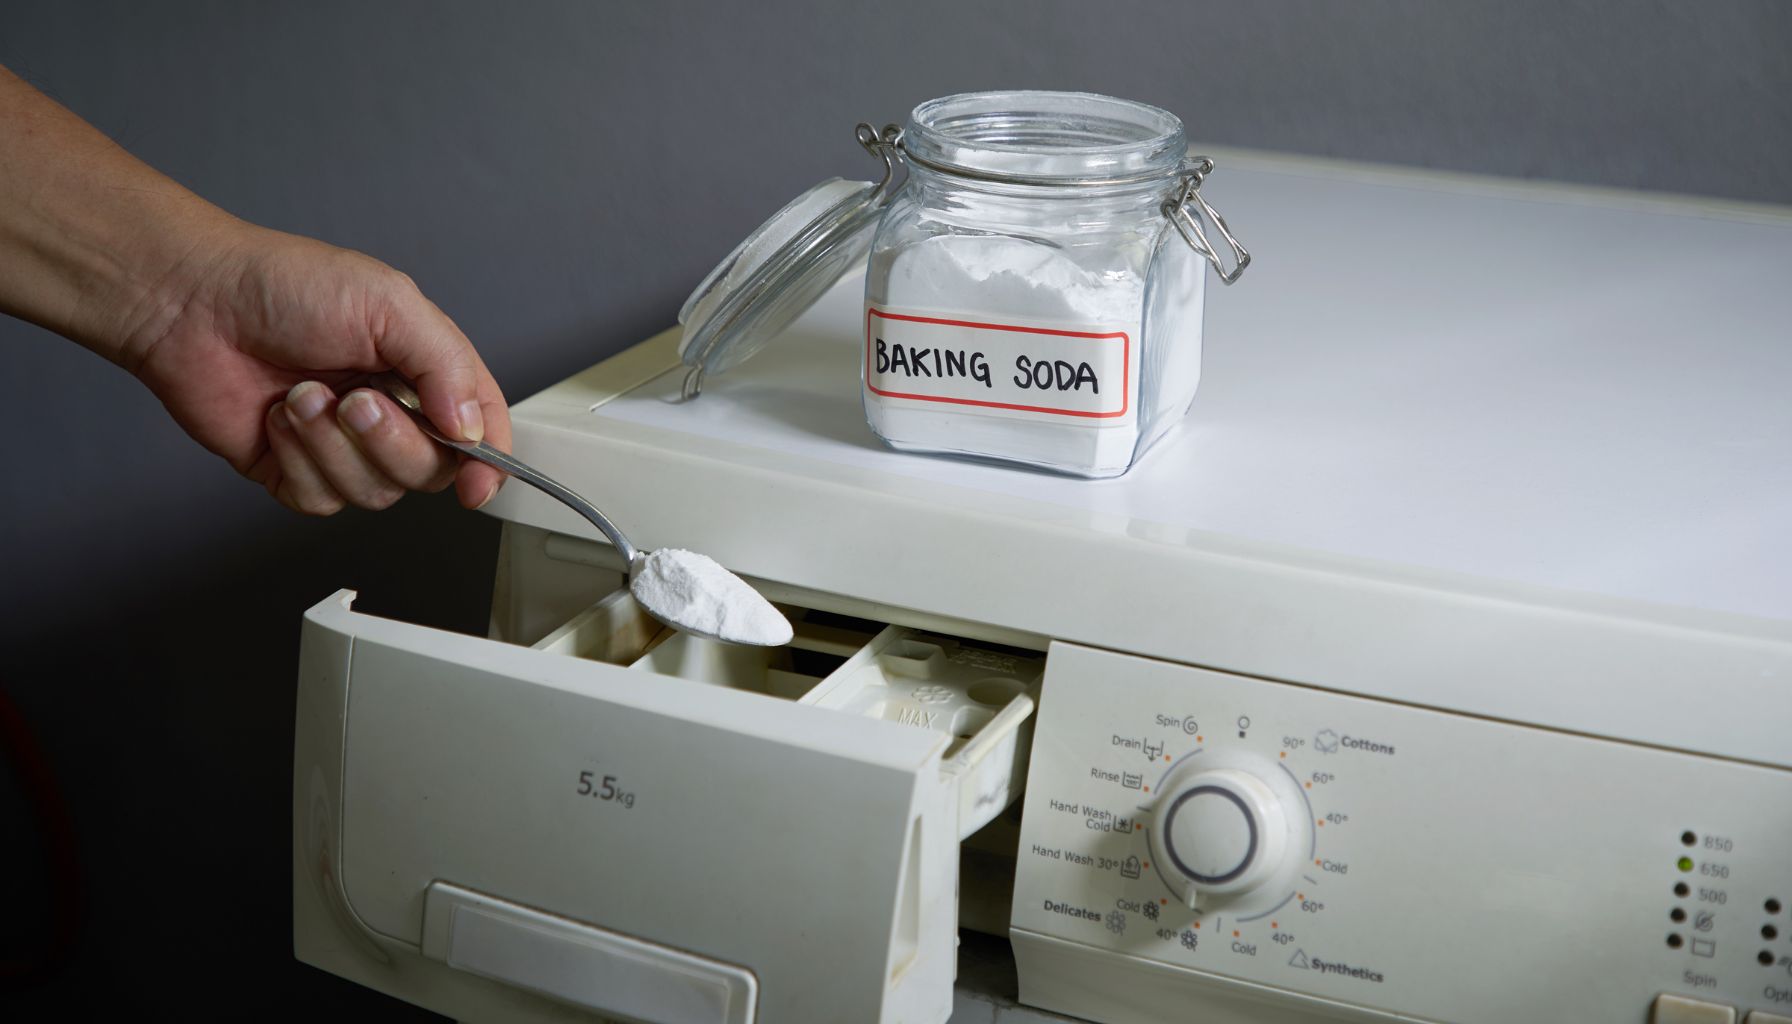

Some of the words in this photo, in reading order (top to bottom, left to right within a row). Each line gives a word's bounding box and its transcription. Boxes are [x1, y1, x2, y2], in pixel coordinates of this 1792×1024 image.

[876, 338, 992, 388] BAKING
[1013, 354, 1099, 395] SODA
[898, 707, 937, 730] MAX
[1156, 714, 1180, 728] Spin
[1112, 735, 1141, 749] Drain
[1341, 736, 1395, 755] Cottons
[1091, 768, 1120, 783] Rinse
[1050, 799, 1079, 815] Hand
[1082, 806, 1112, 820] Wash
[1086, 818, 1111, 833] Cold
[1704, 836, 1733, 852] 850
[1032, 844, 1061, 860] Hand
[1065, 851, 1094, 867] Wash
[1322, 860, 1348, 875] Cold
[1700, 863, 1729, 879] 650
[1698, 888, 1727, 905] 500
[1044, 900, 1101, 921] Delicates
[1116, 899, 1141, 914] Cold
[1231, 941, 1257, 957] Cold
[1311, 958, 1384, 983] Synthetics
[1684, 970, 1717, 989] Spin
